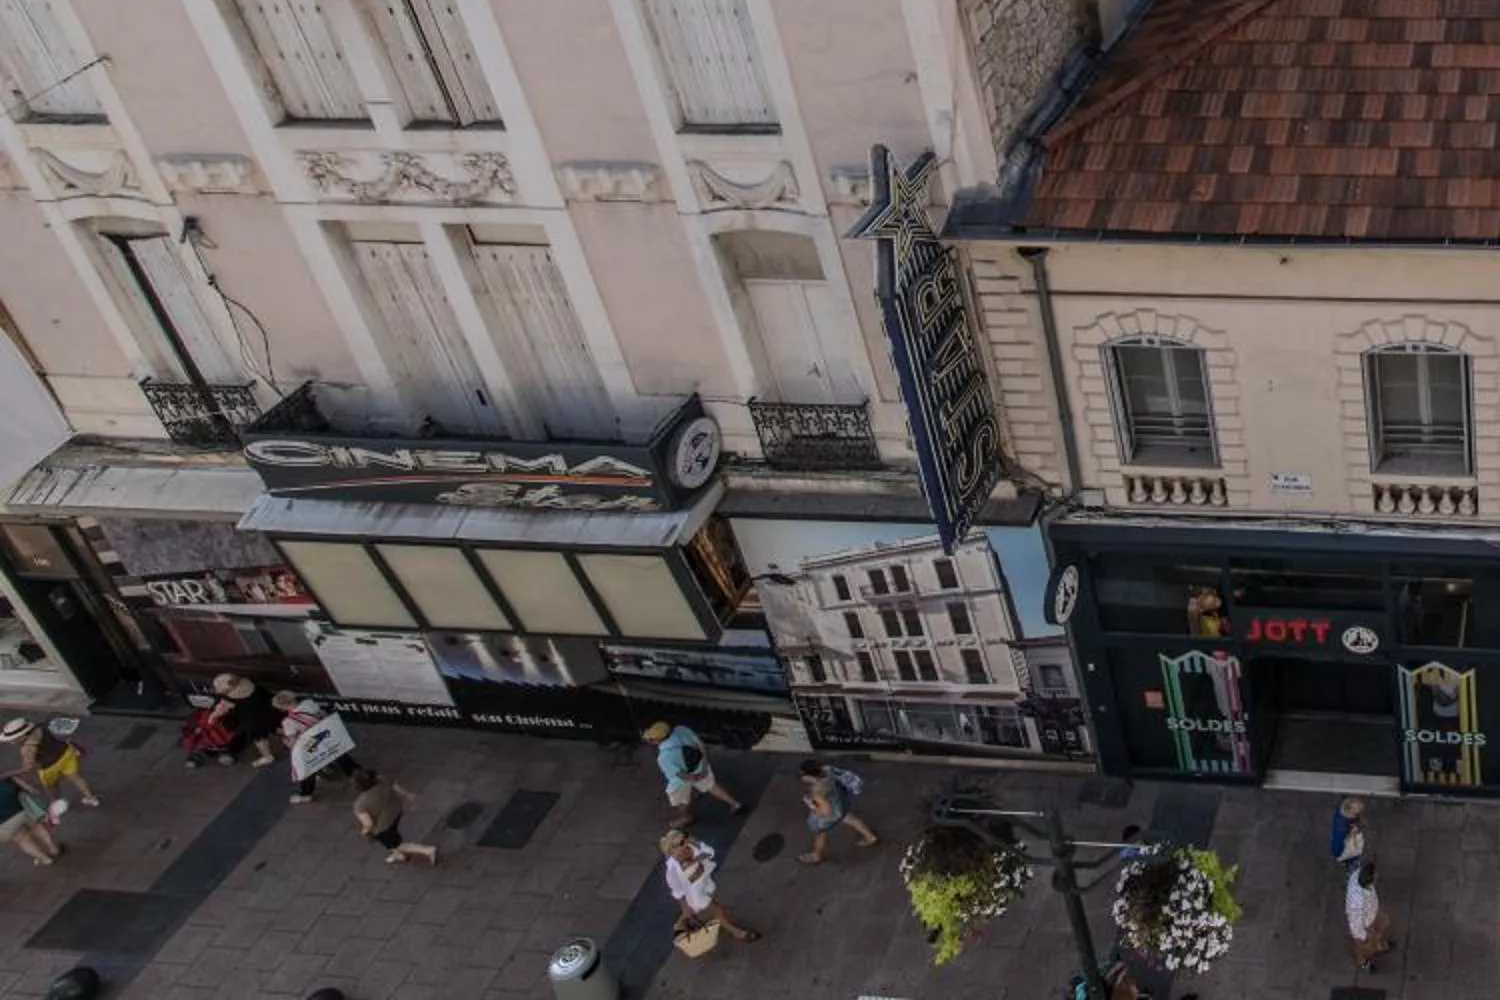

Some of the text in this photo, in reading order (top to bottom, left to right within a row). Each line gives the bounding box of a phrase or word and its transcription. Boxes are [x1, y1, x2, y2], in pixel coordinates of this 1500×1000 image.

[914, 248, 1000, 503] STAR
[243, 439, 653, 476] CINEMA
[146, 580, 209, 606] STAR
[1247, 617, 1330, 644] JOTT
[1167, 716, 1246, 733] SOLDES
[1404, 729, 1487, 746] SOLDES
